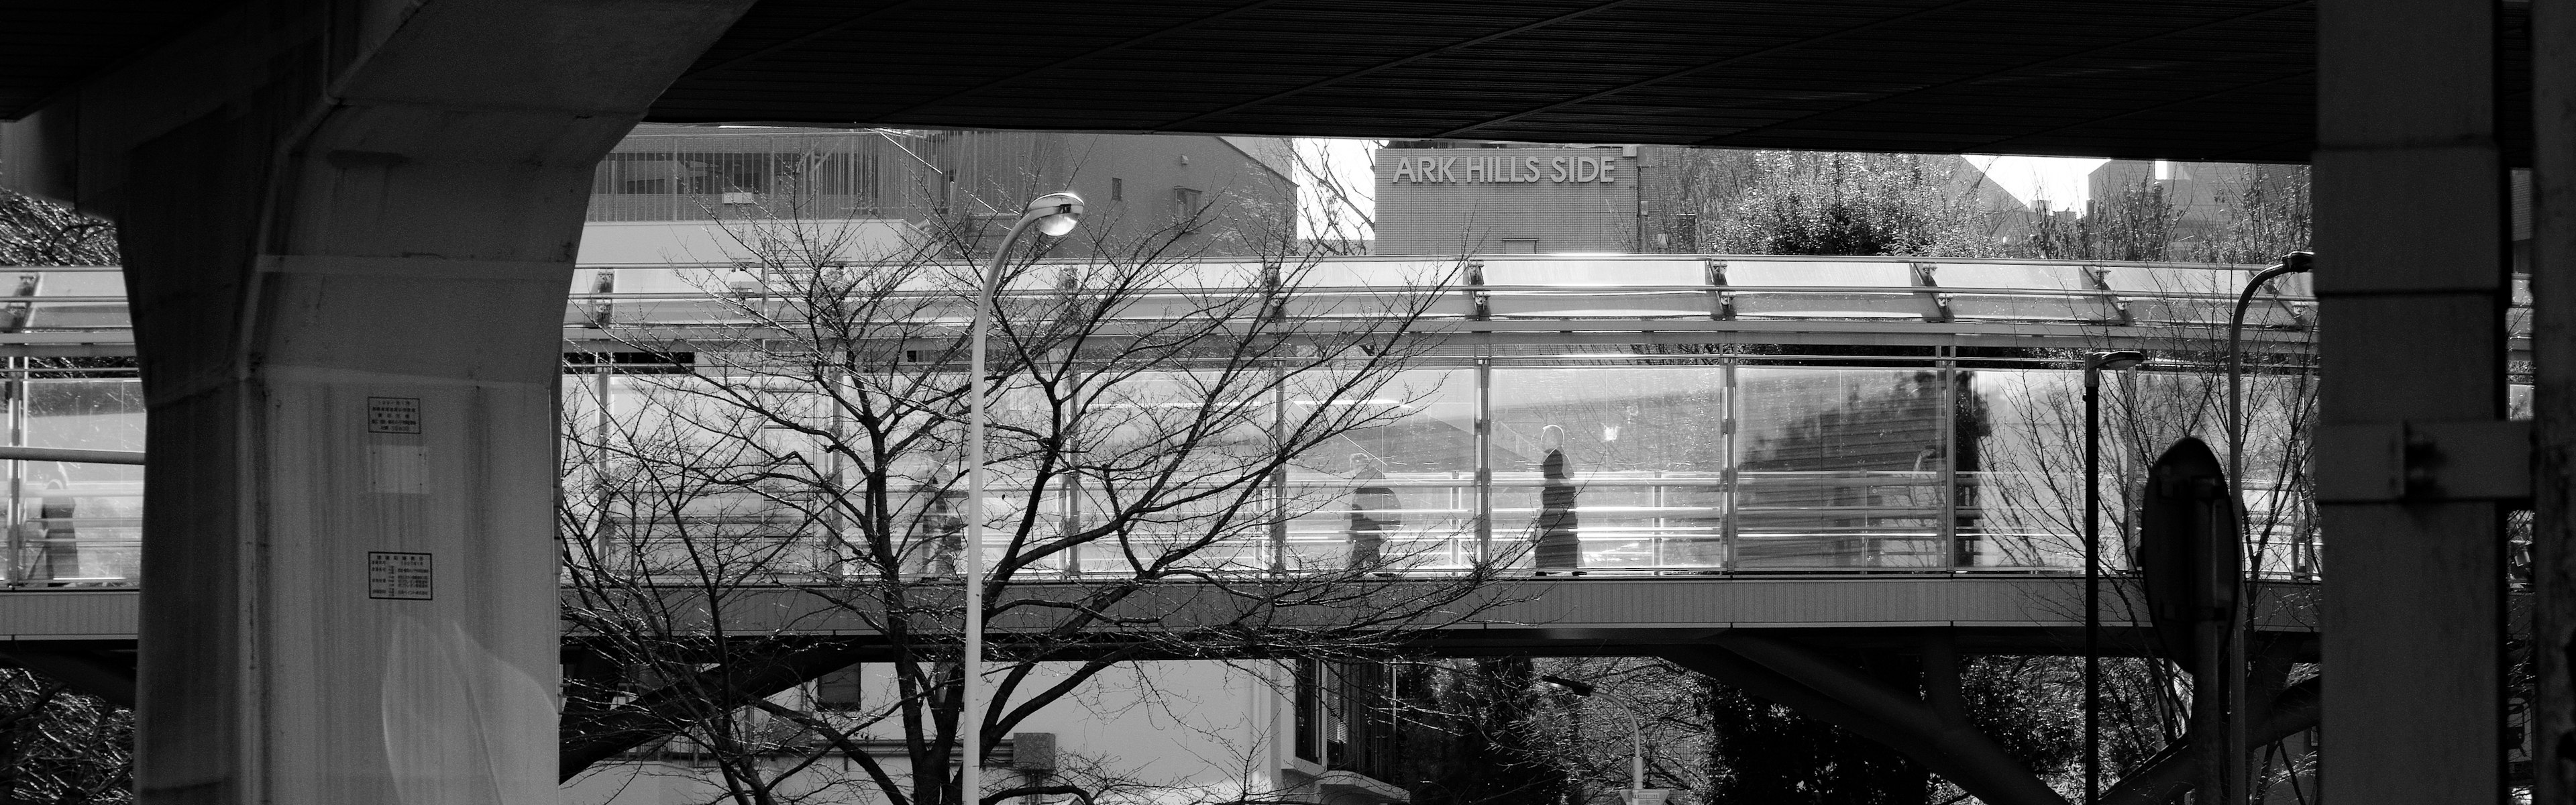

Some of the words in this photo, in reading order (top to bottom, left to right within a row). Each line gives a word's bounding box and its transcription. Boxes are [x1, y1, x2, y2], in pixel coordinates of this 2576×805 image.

[1393, 156, 1457, 182] ARK
[1466, 156, 1541, 182] HILLS
[1550, 156, 1615, 182] SIDE
